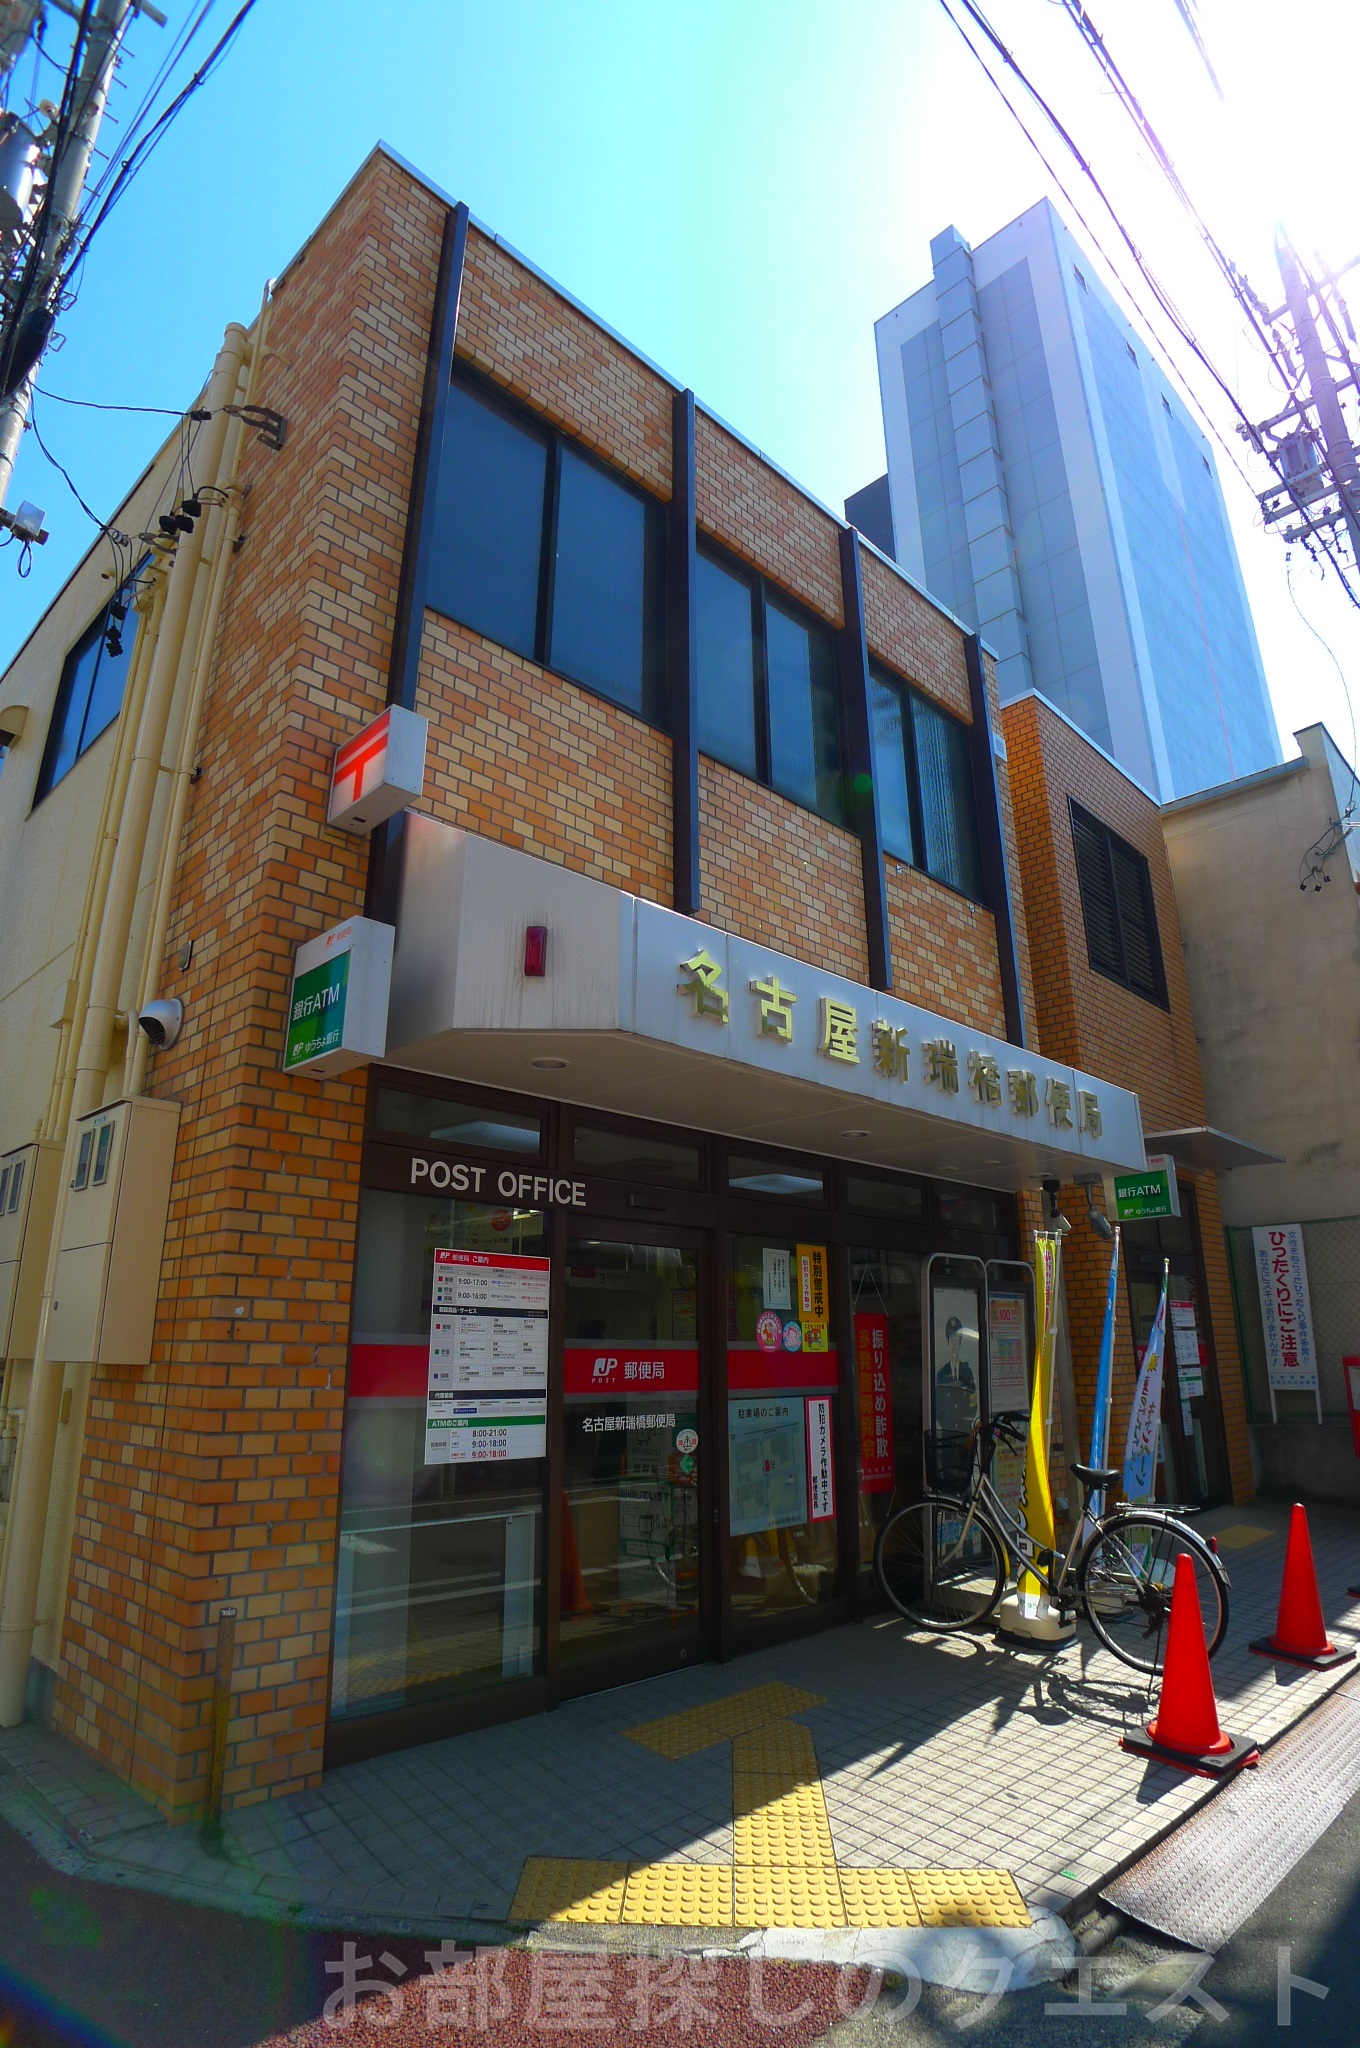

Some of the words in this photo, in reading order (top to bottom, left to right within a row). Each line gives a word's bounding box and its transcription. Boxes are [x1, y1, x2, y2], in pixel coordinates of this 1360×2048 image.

[292, 982, 341, 1022] 銀行ATM
[304, 1028, 340, 1055] ゆうちょ銀行
[676, 949, 1103, 1138] 名古屋新瑞橋郵便局
[410, 1157, 486, 1193] POST
[498, 1171, 587, 1207] OFFICE
[1117, 1183, 1161, 1199] 銀行ATM
[1135, 1205, 1167, 1216] ゆうちょ銀行
[452, 1253, 470, 1263] 郵便局
[472, 1255, 490, 1265] ご案内
[458, 1278, 488, 1286] 9:00-17:00
[802, 1259, 811, 1310] 防犯カメラ作動中
[812, 1251, 824, 1318] 特別警戒中
[1258, 1250, 1279, 1367] あなたにスキはありませんか!
[1268, 1231, 1299, 1368] ひったくりにご注意
[592, 1357, 618, 1377] JP
[624, 1361, 665, 1380] 郵便局
[858, 1329, 875, 1460] 多発警報発令
[871, 1328, 889, 1459] 振り込め詐欺
[431, 1418, 469, 1429] ATMのご案内
[582, 1413, 676, 1433] 名古屋新瑞橋郵便局
[738, 1406, 789, 1419] 駐車場のご案内
[471, 1439, 507, 1449] 9:00-18:00
[472, 1428, 507, 1438] 8:00-21:00
[471, 1450, 507, 1459] 9:00-18:00
[817, 1402, 830, 1513] 防犯カメラ作動中です
